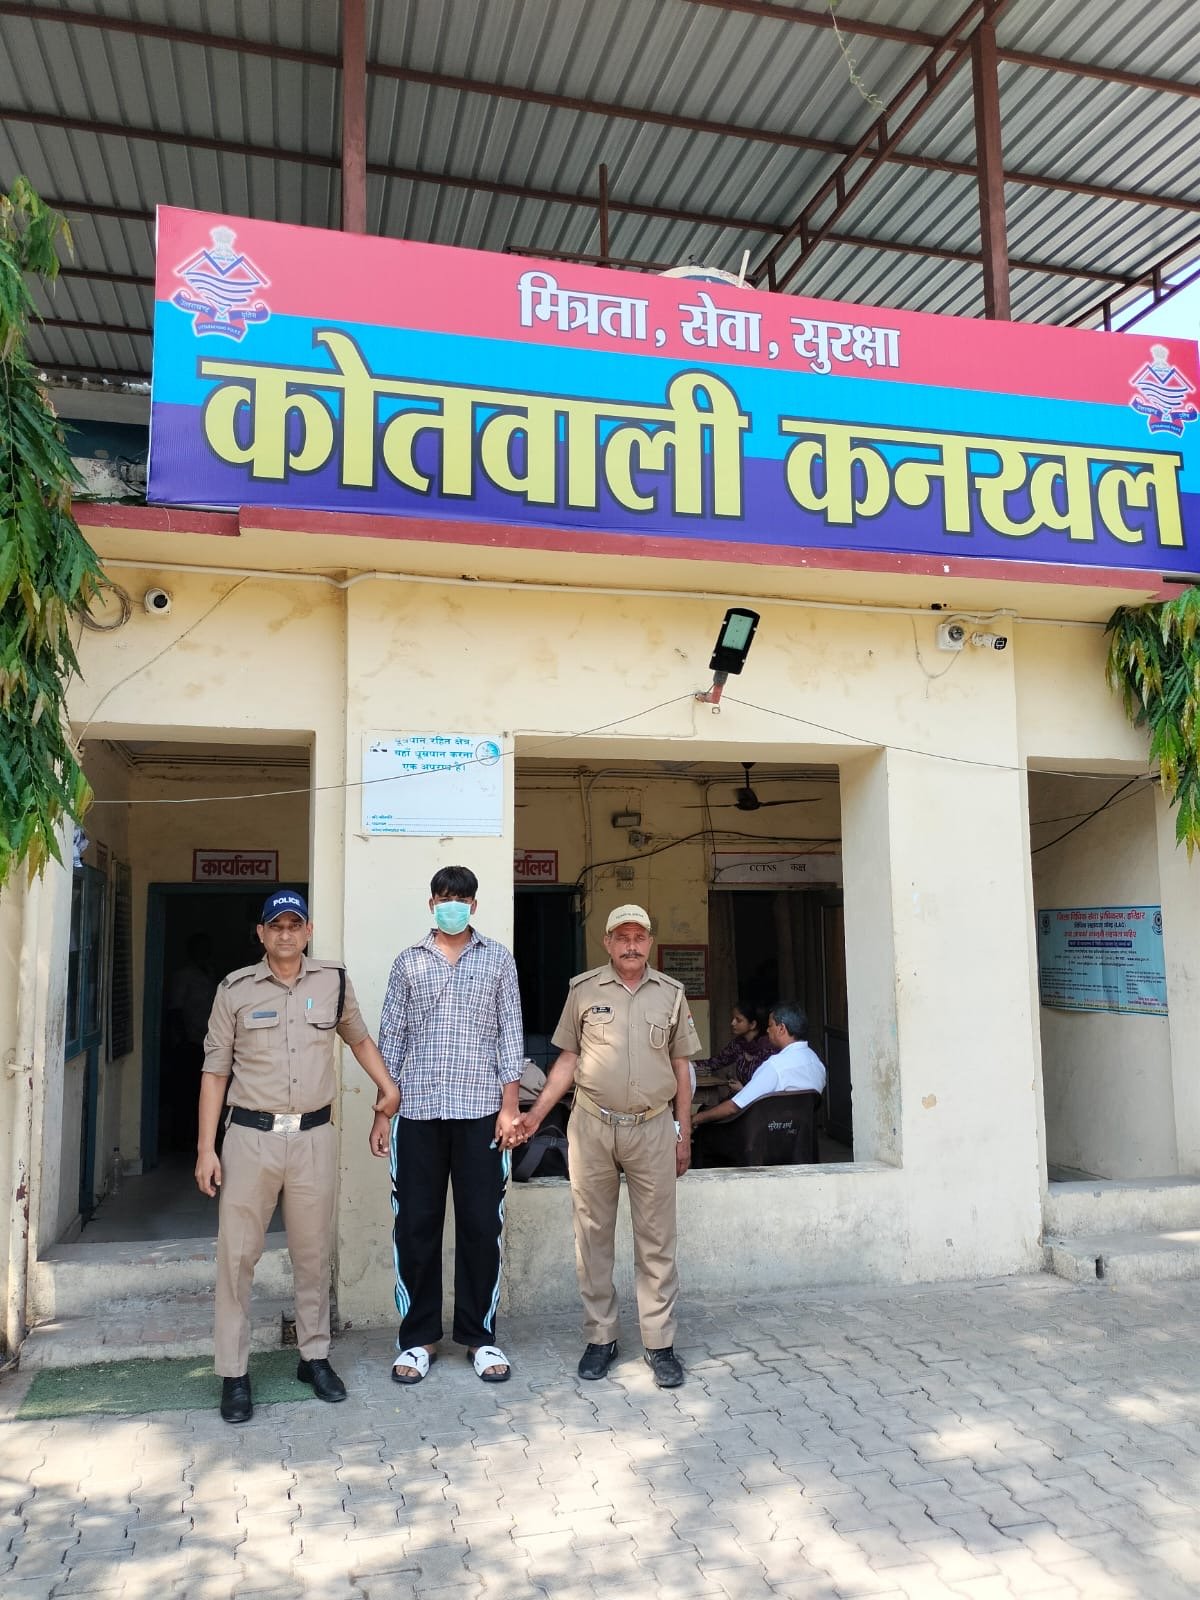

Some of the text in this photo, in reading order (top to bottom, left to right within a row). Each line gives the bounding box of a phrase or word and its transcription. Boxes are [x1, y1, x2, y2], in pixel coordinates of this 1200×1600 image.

[518, 270, 901, 375] मित्रता, सेवा, सुरक्षा
[196, 327, 1187, 549] कोतवाली कनखल
[199, 854, 273, 876] कार्यालय
[749, 863, 806, 872] CCTNS कक्ष
[273, 896, 301, 907] POLICE
